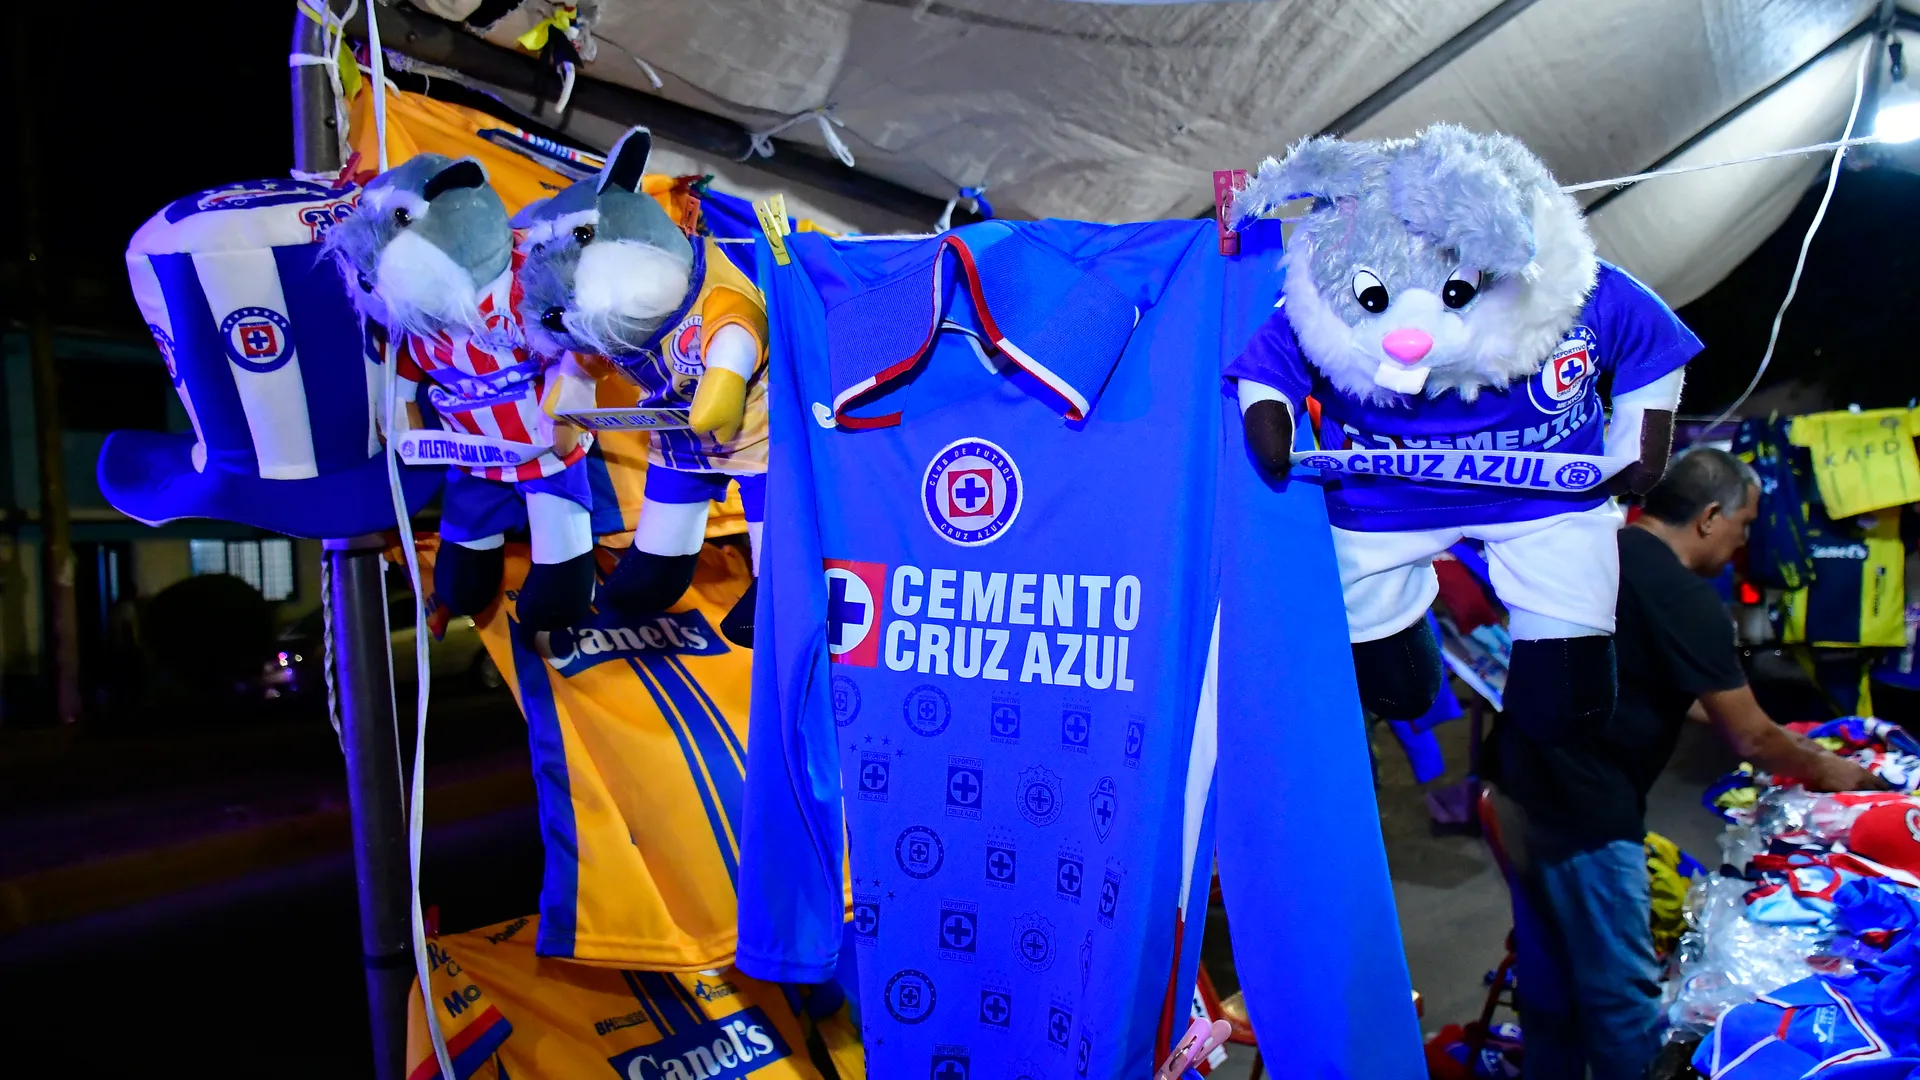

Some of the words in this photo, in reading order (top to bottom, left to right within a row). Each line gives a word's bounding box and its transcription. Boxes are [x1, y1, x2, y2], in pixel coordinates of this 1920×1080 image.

[1552, 344, 1586, 360] DEPORTIVO
[678, 365, 698, 376] SAN
[418, 440, 459, 461] ATLETICO
[459, 443, 479, 463] SAN
[480, 446, 504, 463] LUIS
[929, 458, 949, 486] CLUB
[954, 447, 967, 458] DE
[976, 447, 1013, 481] FUTBOL
[1349, 454, 1445, 478] CRUZ
[1453, 455, 1550, 488] AZUL
[940, 523, 969, 540] CRUZ
[977, 520, 1004, 539] AZUL
[891, 565, 1142, 631] CEMENTO
[535, 617, 709, 670] Canel's
[885, 620, 1010, 682] CRUZ
[1019, 631, 1135, 692] AZUL
[950, 757, 982, 768] DEPORTIVO
[948, 807, 964, 817] CRUZ
[965, 809, 980, 819] AZUL
[1018, 796, 1030, 817] CLUB
[1029, 801, 1061, 822] DEPORTIVO
[943, 901, 976, 911] DEPORTIVO
[1023, 949, 1054, 970] DEPORTIVO
[628, 1019, 775, 1080] Canel's
